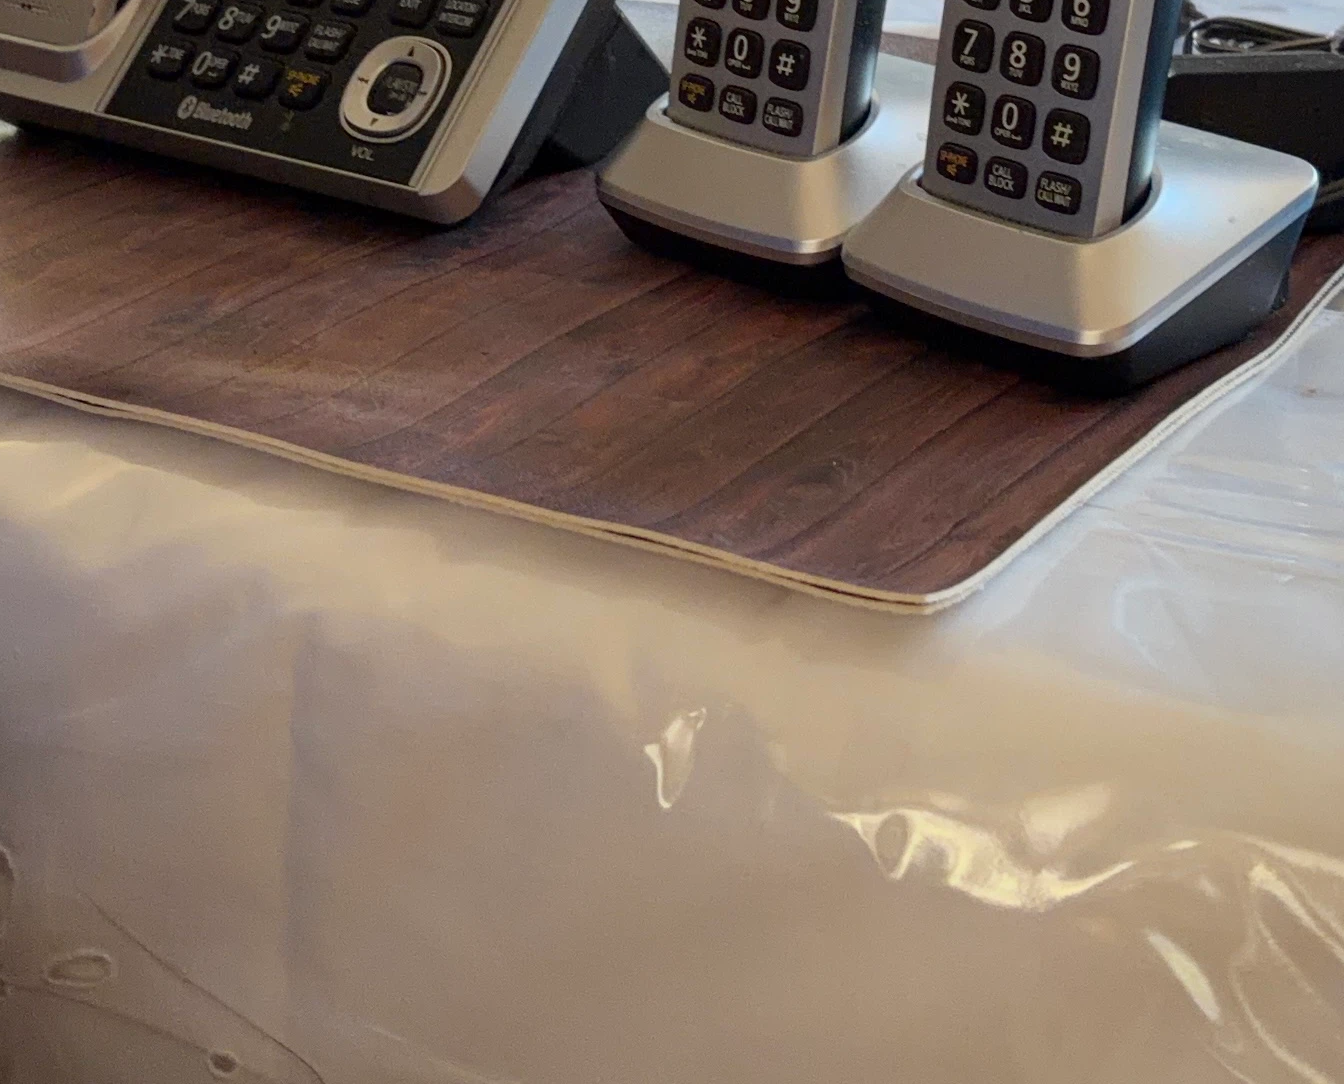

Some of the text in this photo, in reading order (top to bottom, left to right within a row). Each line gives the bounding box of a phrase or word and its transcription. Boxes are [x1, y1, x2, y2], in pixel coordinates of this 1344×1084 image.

[218, 6, 239, 30] 8
[261, 15, 282, 39] 9
[734, 34, 748, 60] 0
[963, 28, 979, 55] 7
[192, 51, 211, 76] 0
[1009, 40, 1027, 69] 8
[1062, 52, 1081, 82] 9
[1002, 102, 1018, 130] 0
[989, 175, 1014, 192] BLOCK
[992, 164, 1012, 180] CALL
